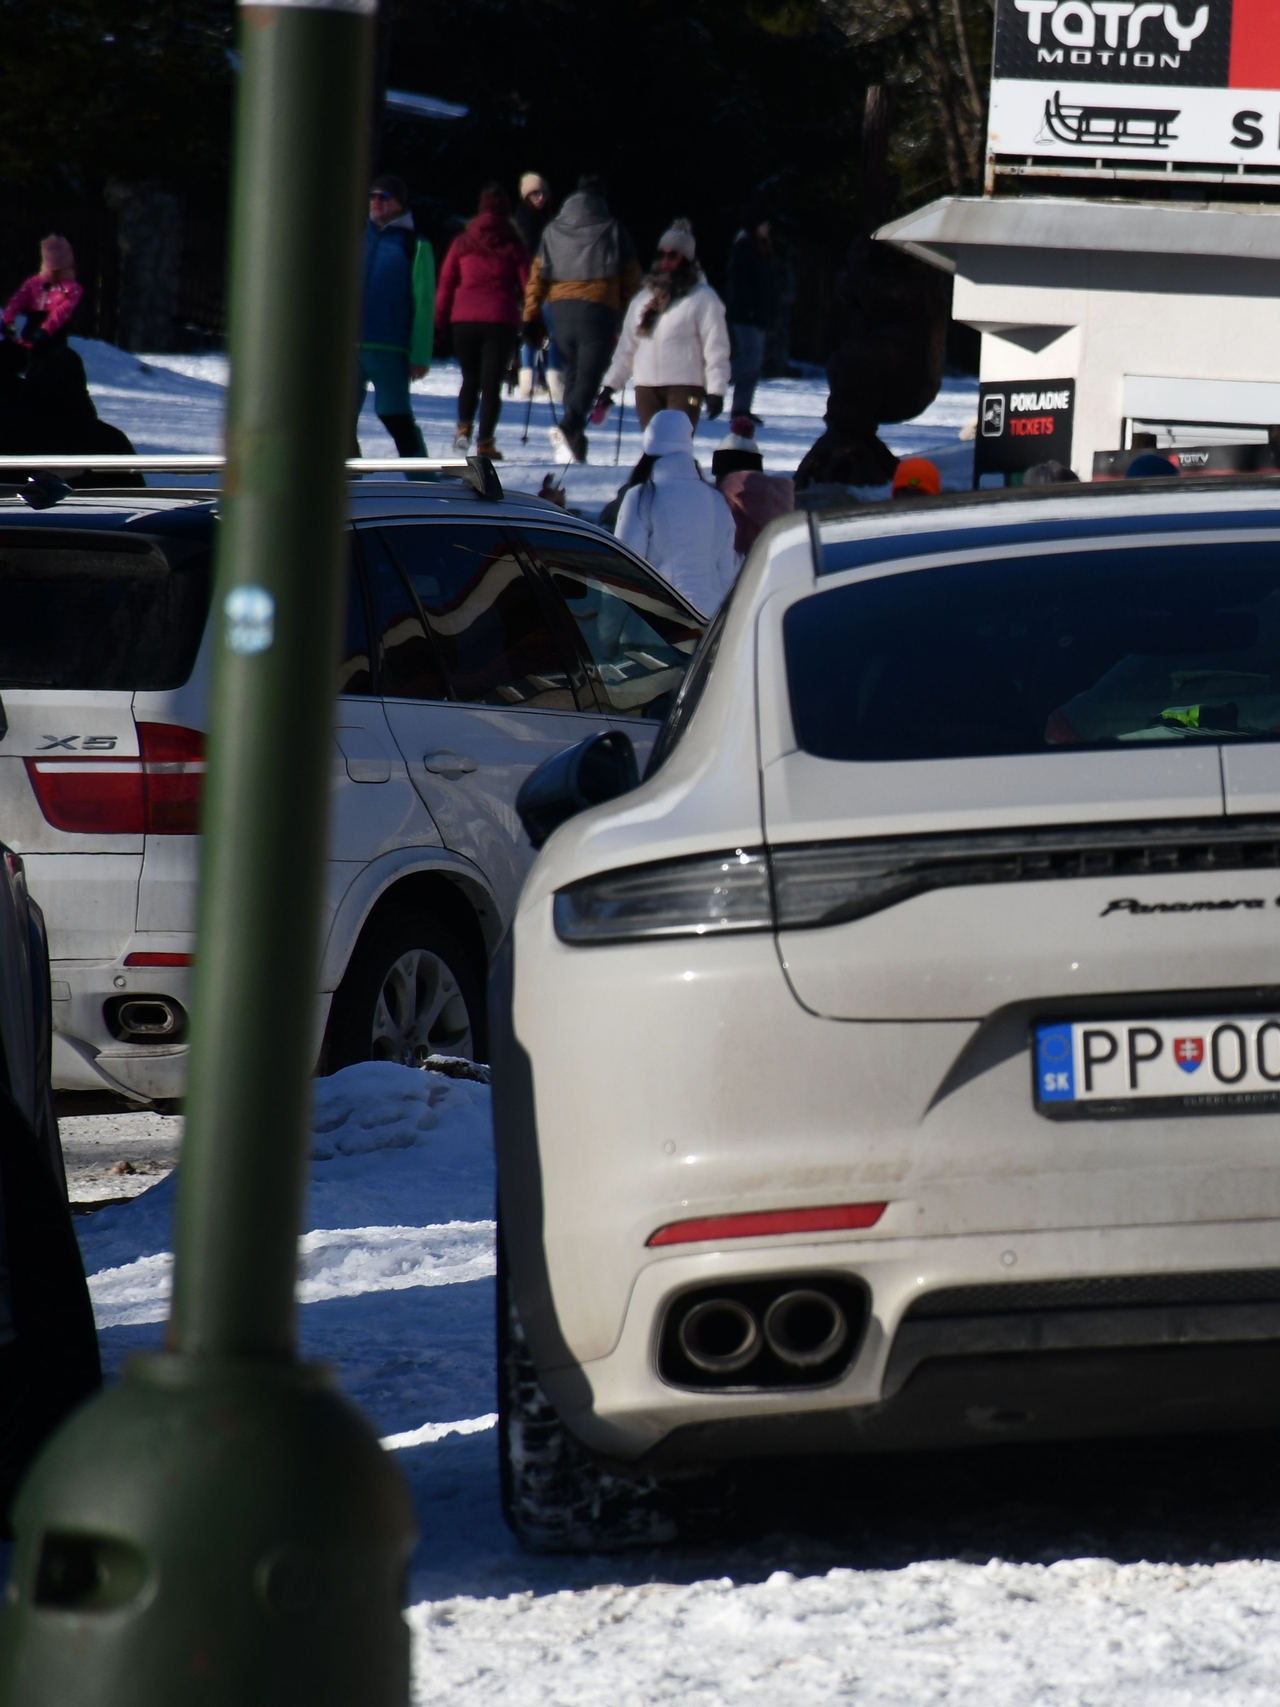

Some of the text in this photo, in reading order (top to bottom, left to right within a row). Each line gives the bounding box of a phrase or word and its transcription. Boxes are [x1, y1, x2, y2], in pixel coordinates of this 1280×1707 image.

[1037, 49, 1180, 68] MOTION
[1010, 391, 1070, 411] POKLADNE
[1010, 417, 1054, 436] TICKETS
[35, 735, 118, 750] X5
[1099, 897, 1265, 917] Panamera
[1081, 1026, 1164, 1092] PP
[1044, 1075, 1070, 1091] SK
